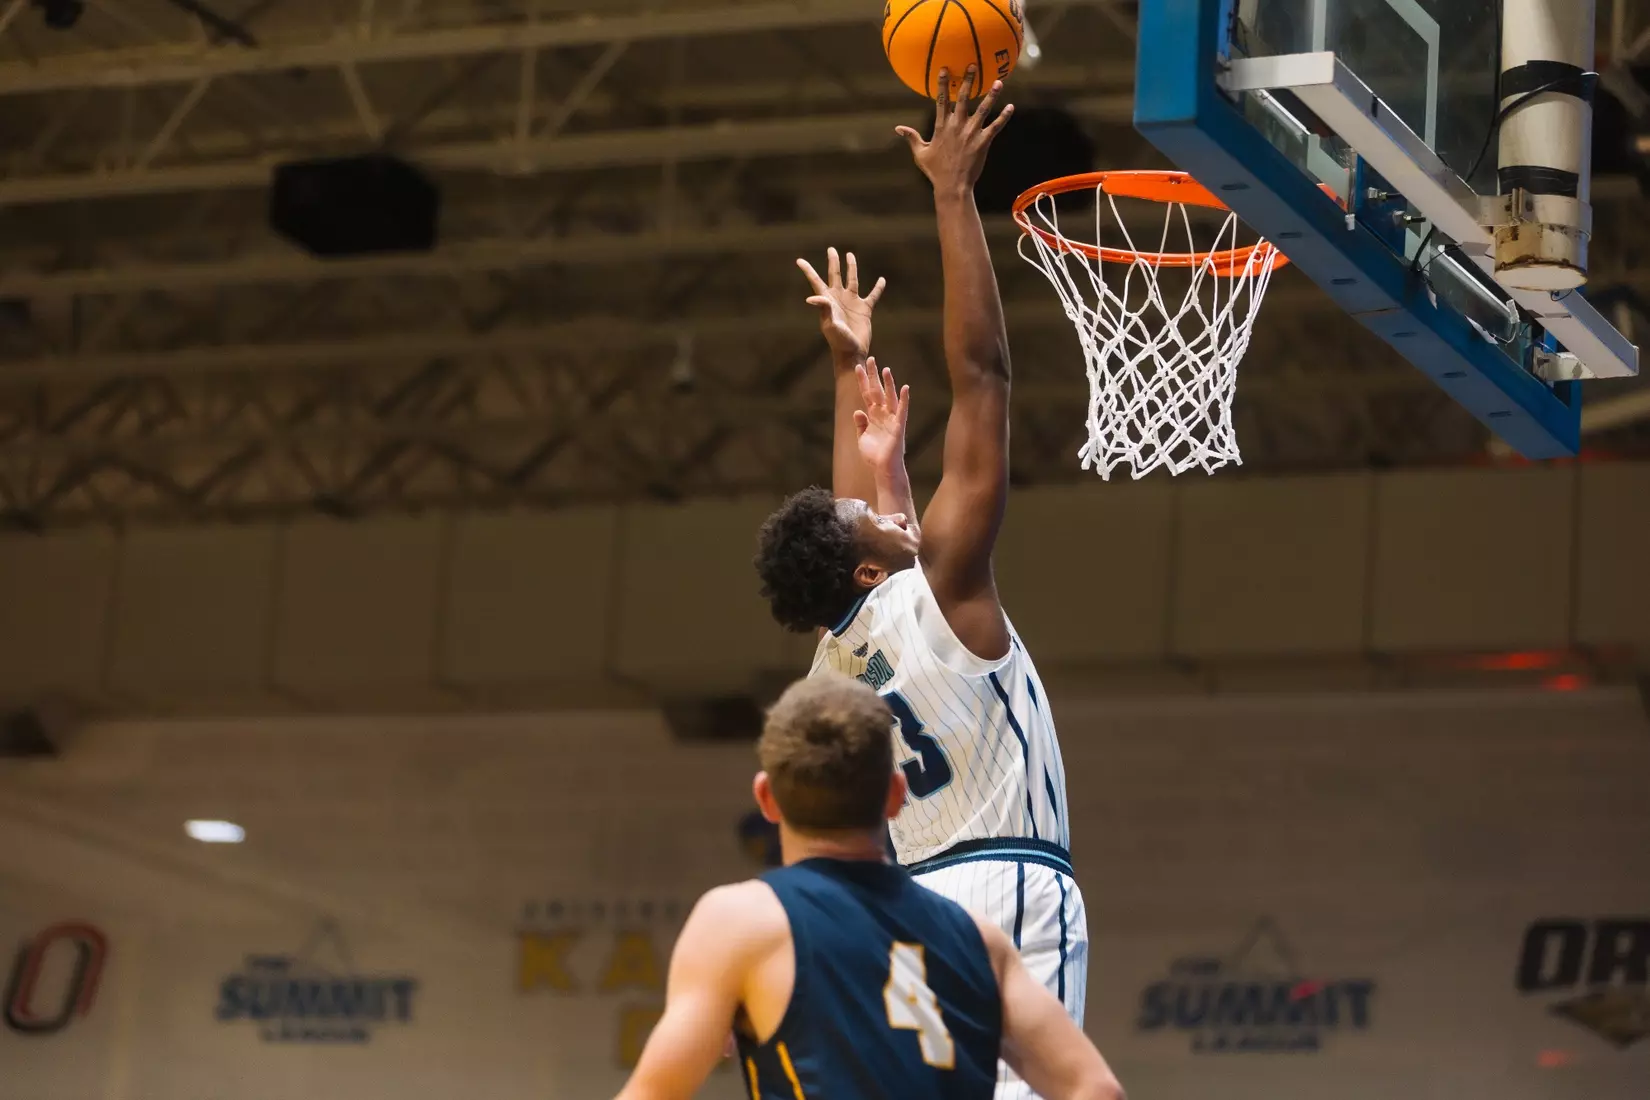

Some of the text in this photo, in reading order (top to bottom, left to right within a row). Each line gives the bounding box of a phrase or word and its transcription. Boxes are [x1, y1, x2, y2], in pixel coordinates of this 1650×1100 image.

[883, 688, 954, 807] 3
[882, 939, 956, 1071] 4
[1137, 979, 1376, 1031] SUMMIT
